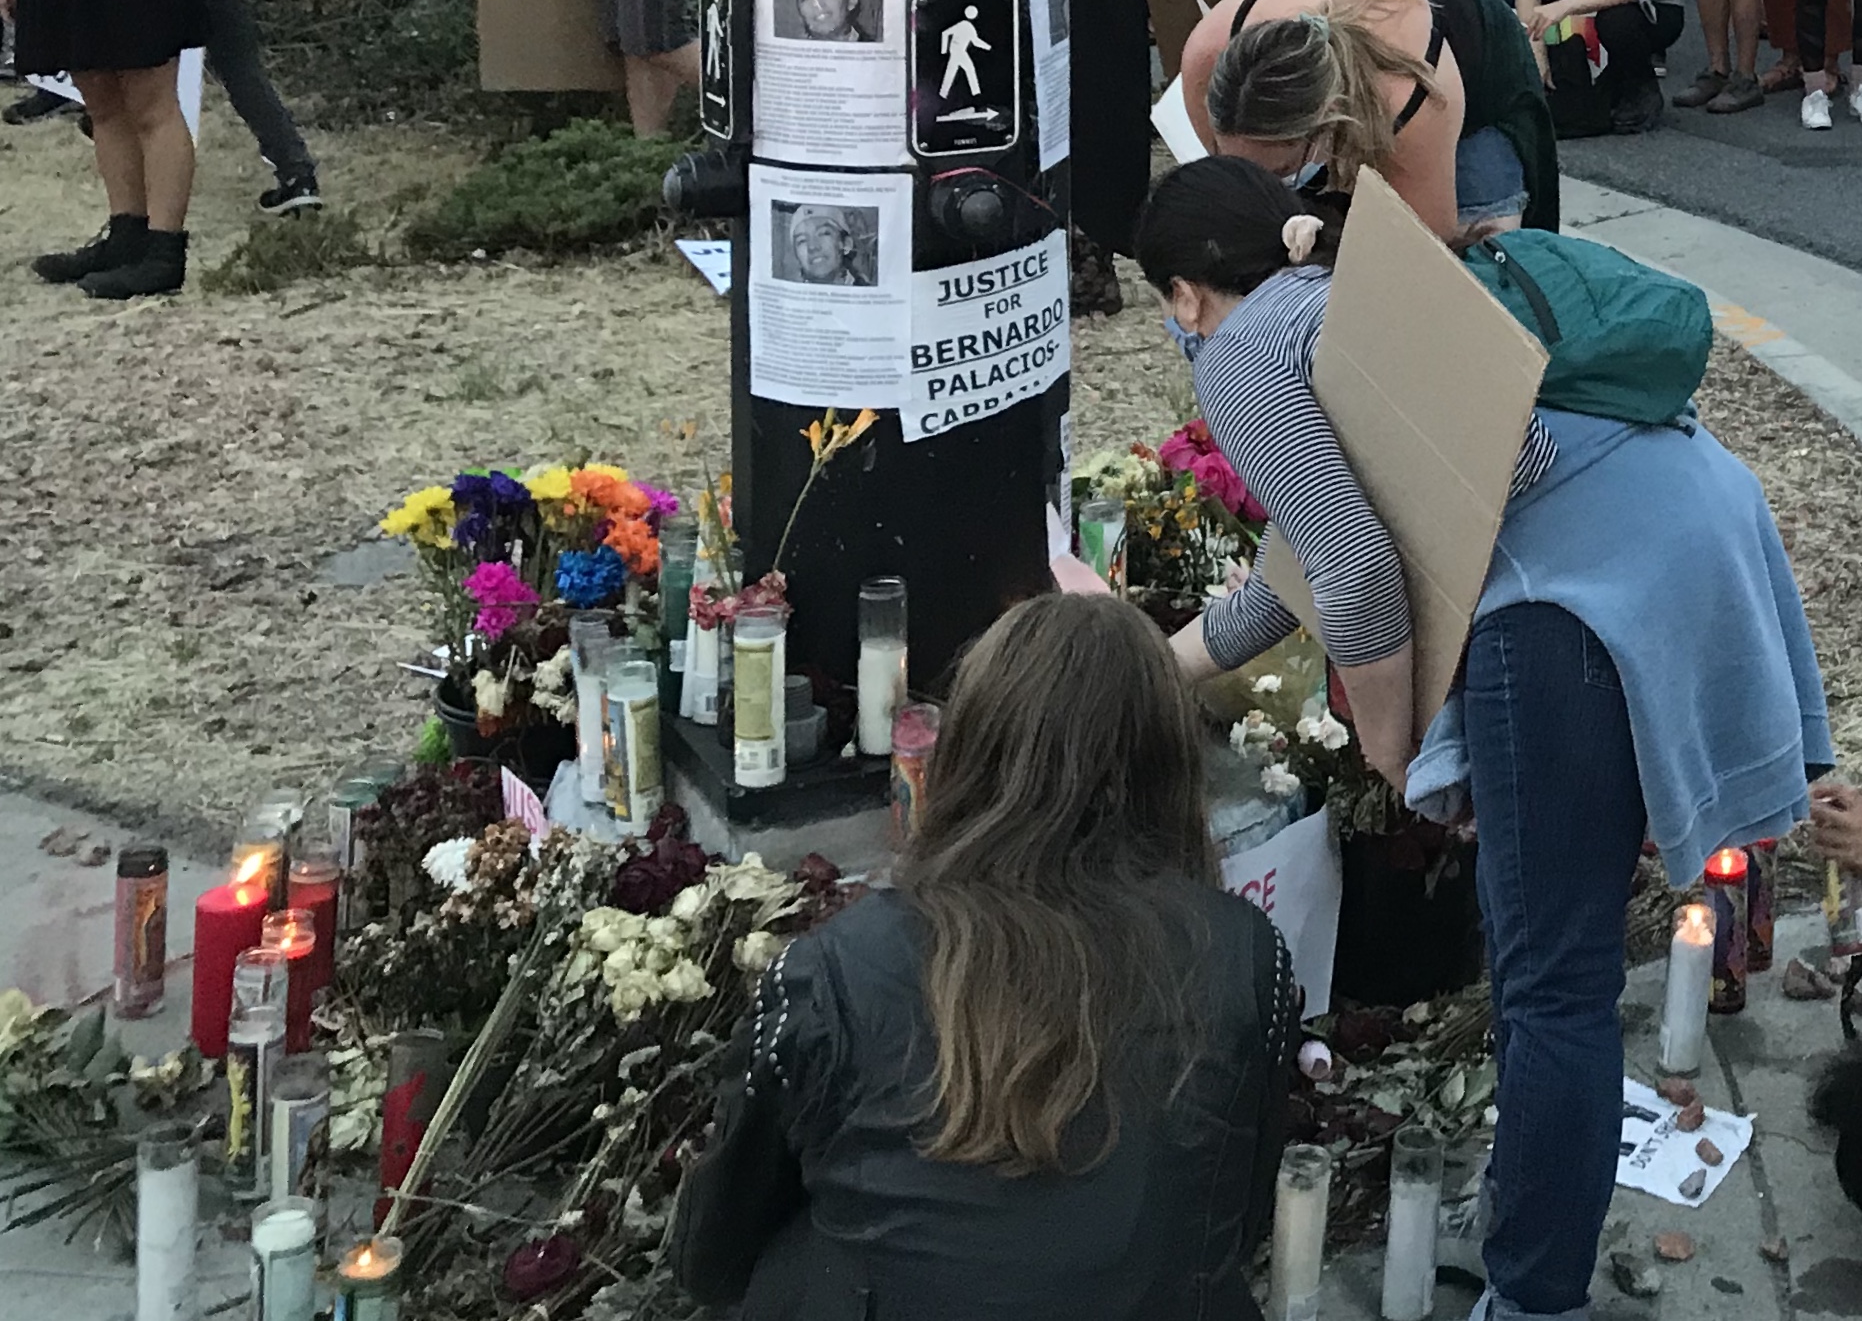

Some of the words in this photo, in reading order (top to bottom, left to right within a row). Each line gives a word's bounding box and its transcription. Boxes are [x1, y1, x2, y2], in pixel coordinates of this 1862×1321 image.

[937, 249, 1049, 303] JUSTICE
[910, 297, 1064, 369] BERNARDO
[984, 293, 1022, 319] FOR
[927, 339, 1060, 401] PALACIOS-
